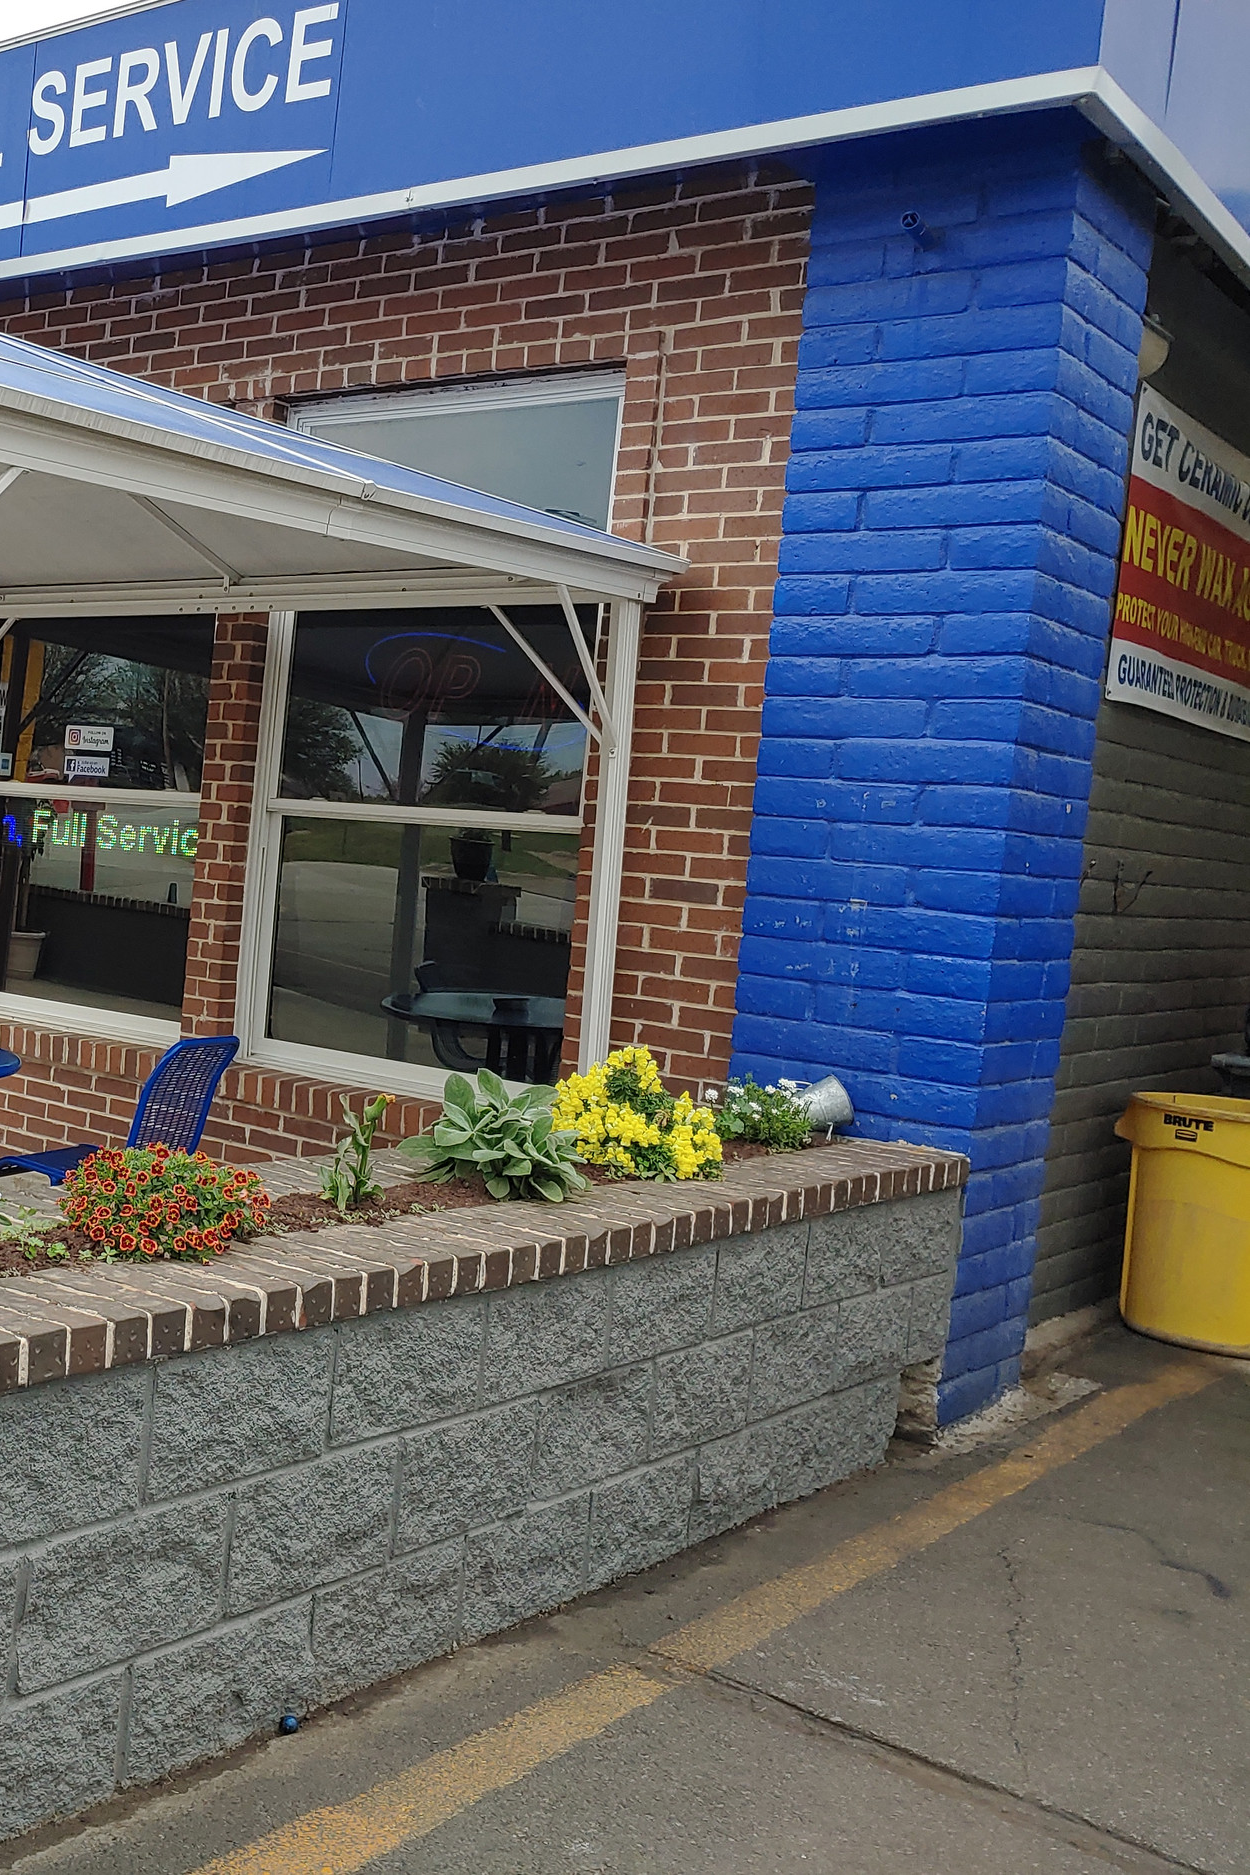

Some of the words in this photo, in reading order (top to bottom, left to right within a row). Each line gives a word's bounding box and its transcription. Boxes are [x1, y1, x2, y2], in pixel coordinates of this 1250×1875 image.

[28, 2, 339, 155] SERVICE
[1141, 412, 1180, 472] GET
[1123, 505, 1197, 592] NEVER
[1196, 543, 1236, 609] WAX
[1116, 592, 1156, 630] PROTECT
[1157, 608, 1179, 641] YOUR
[380, 648, 582, 721] OPN
[82, 736, 109, 747] Instagram
[76, 764, 106, 775] Facebook
[31, 810, 87, 848] Full
[1163, 1113, 1215, 1132] BRUTE
